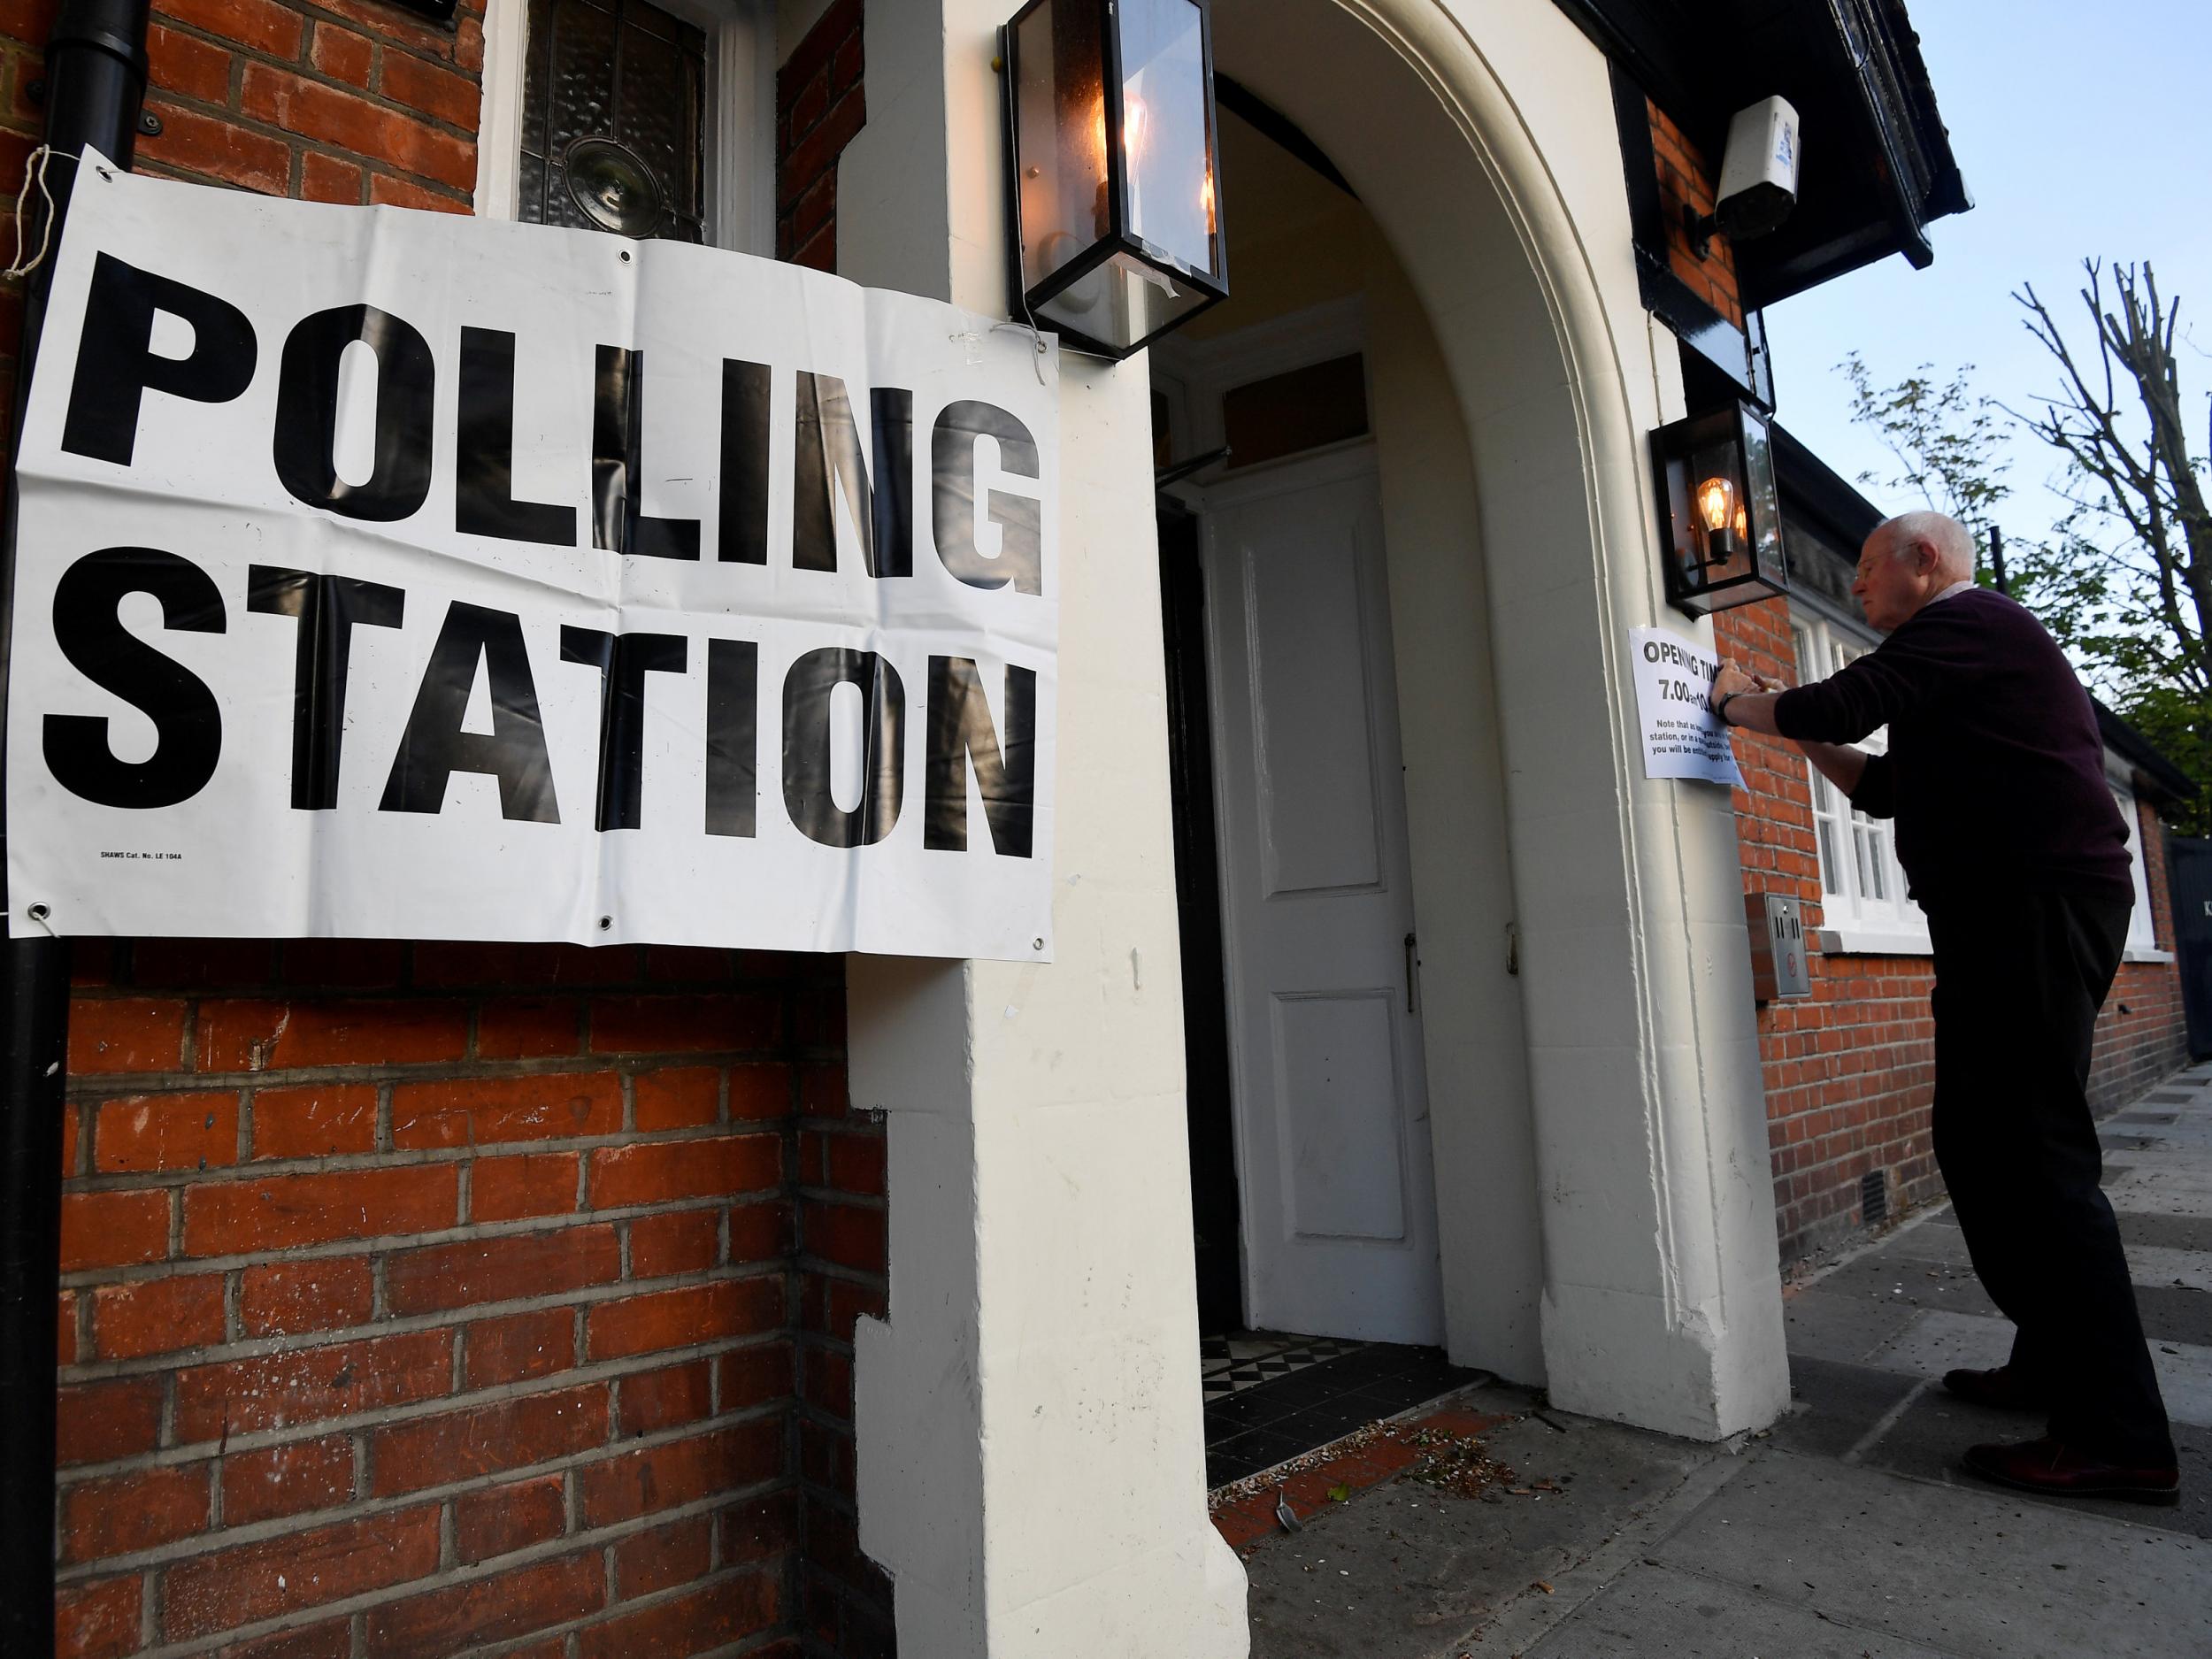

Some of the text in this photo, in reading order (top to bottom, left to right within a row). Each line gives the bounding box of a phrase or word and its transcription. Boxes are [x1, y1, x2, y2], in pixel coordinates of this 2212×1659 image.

[61, 250, 1042, 596] POLLING
[1700, 659, 1718, 683] TIM
[42, 546, 1036, 858] STATION
[1656, 719, 1675, 728] Note
[1677, 719, 1688, 729] that
[1649, 732, 1679, 742] station,
[1652, 746, 1667, 756] you
[1669, 744, 1682, 754] will
[1684, 745, 1692, 754] be
